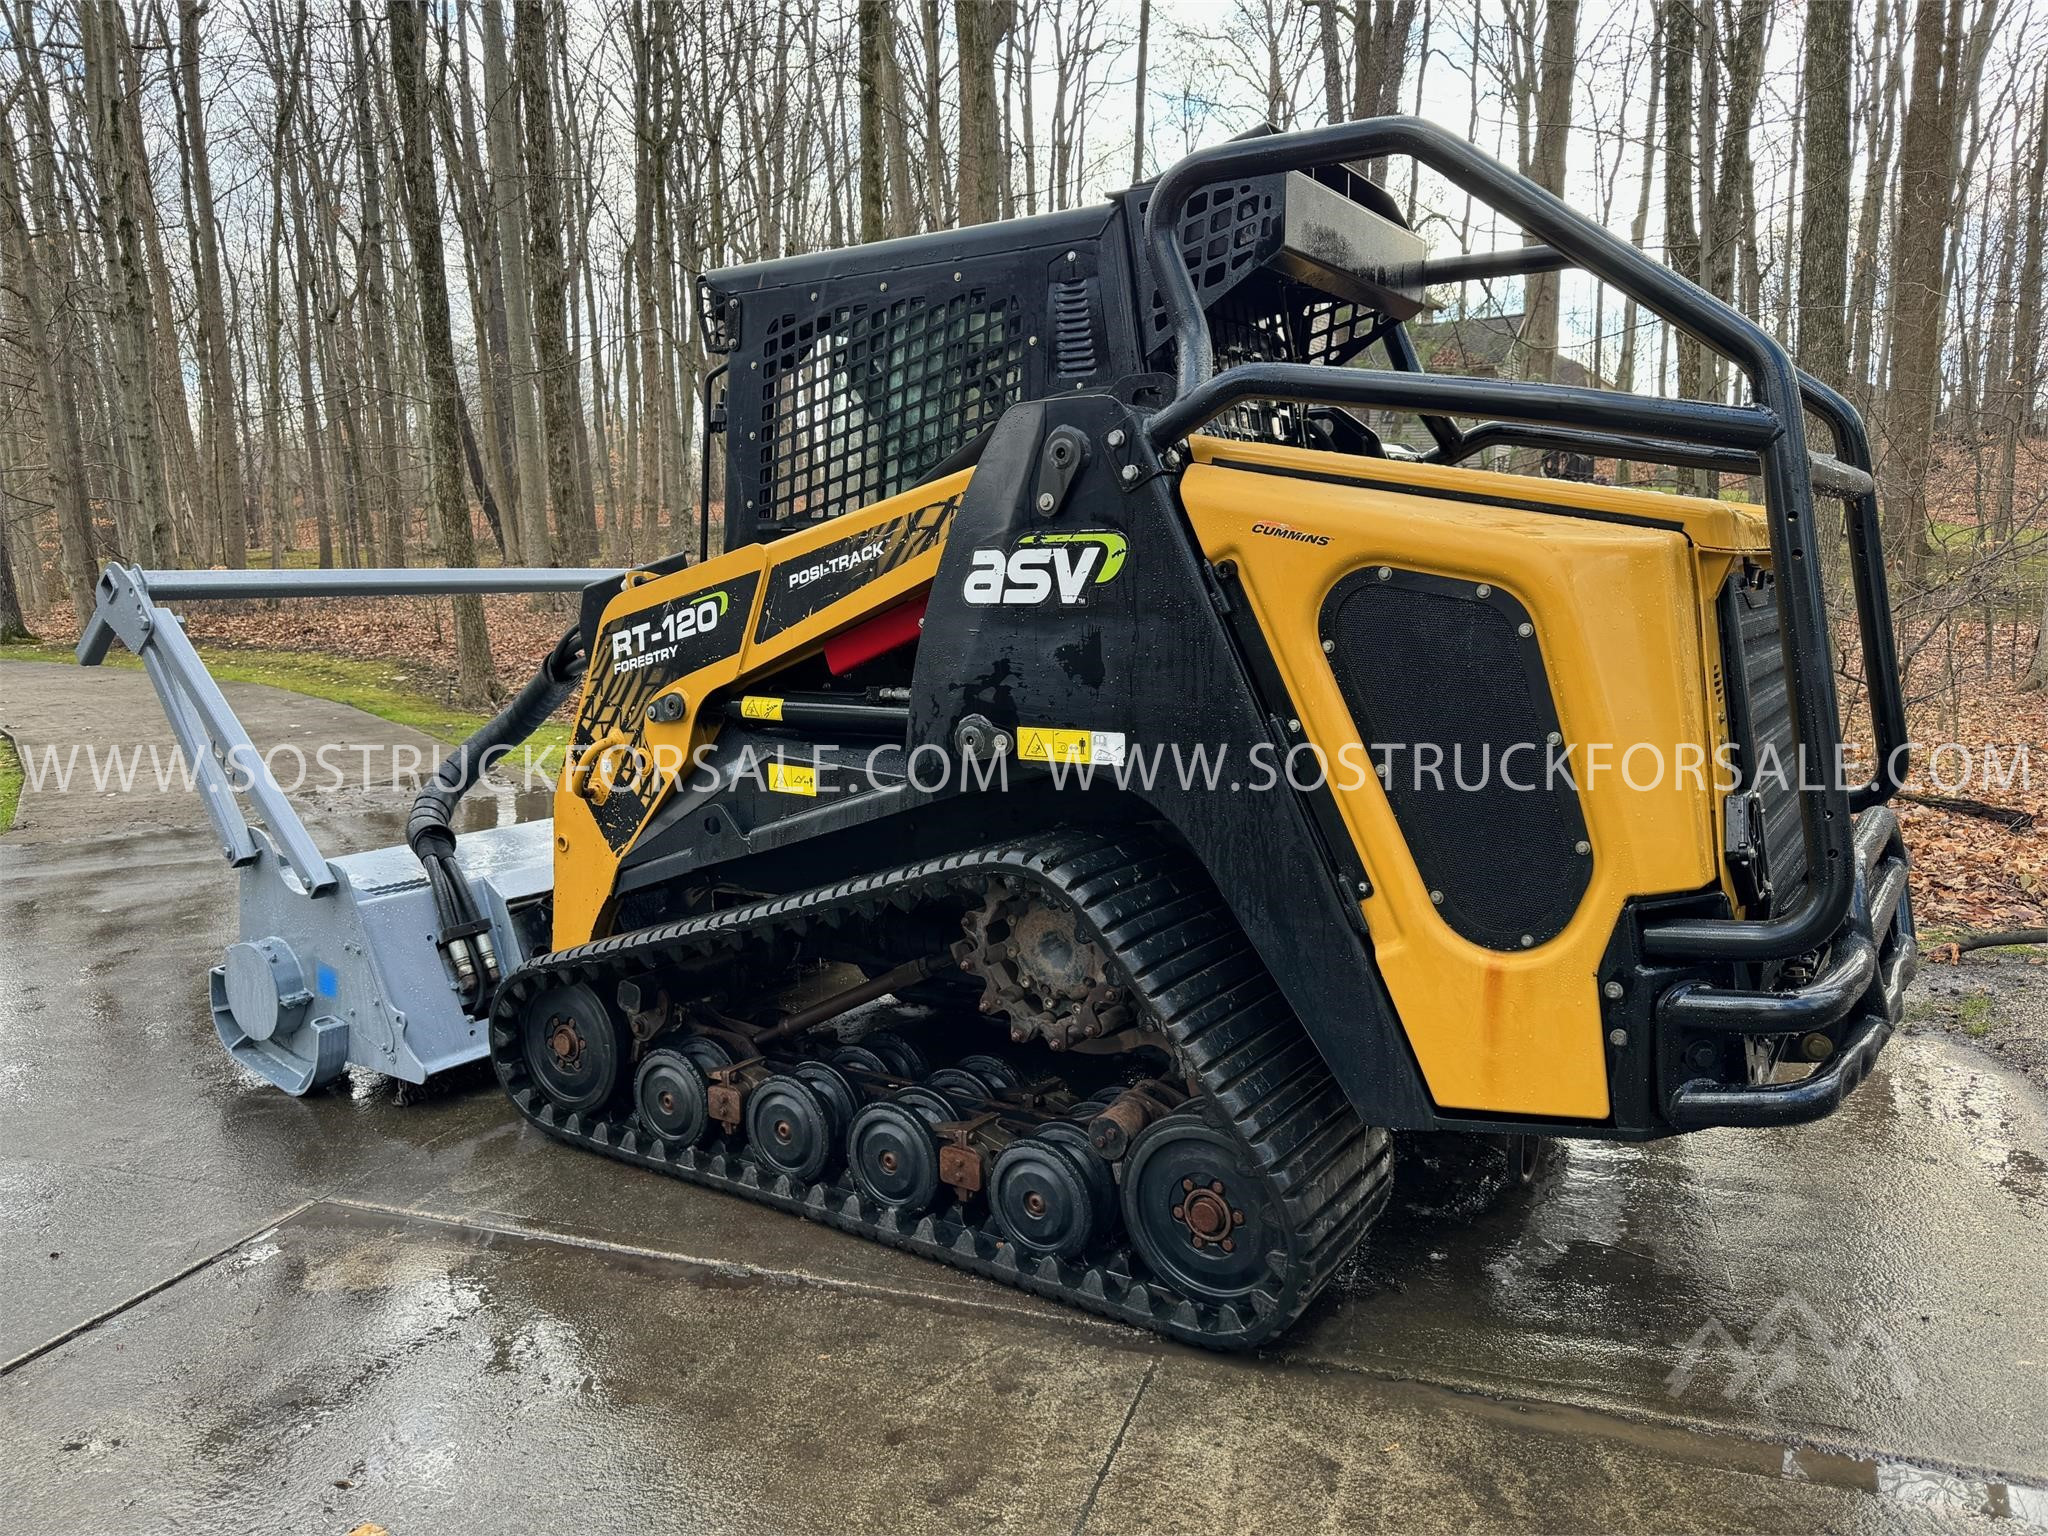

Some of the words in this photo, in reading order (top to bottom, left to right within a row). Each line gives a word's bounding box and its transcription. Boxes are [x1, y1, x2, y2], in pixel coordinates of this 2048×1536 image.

[1251, 523, 1330, 546] CUMMINS
[788, 540, 885, 589] POSI-TRACK
[612, 601, 718, 660] RT-120
[614, 644, 679, 676] FORESTRY
